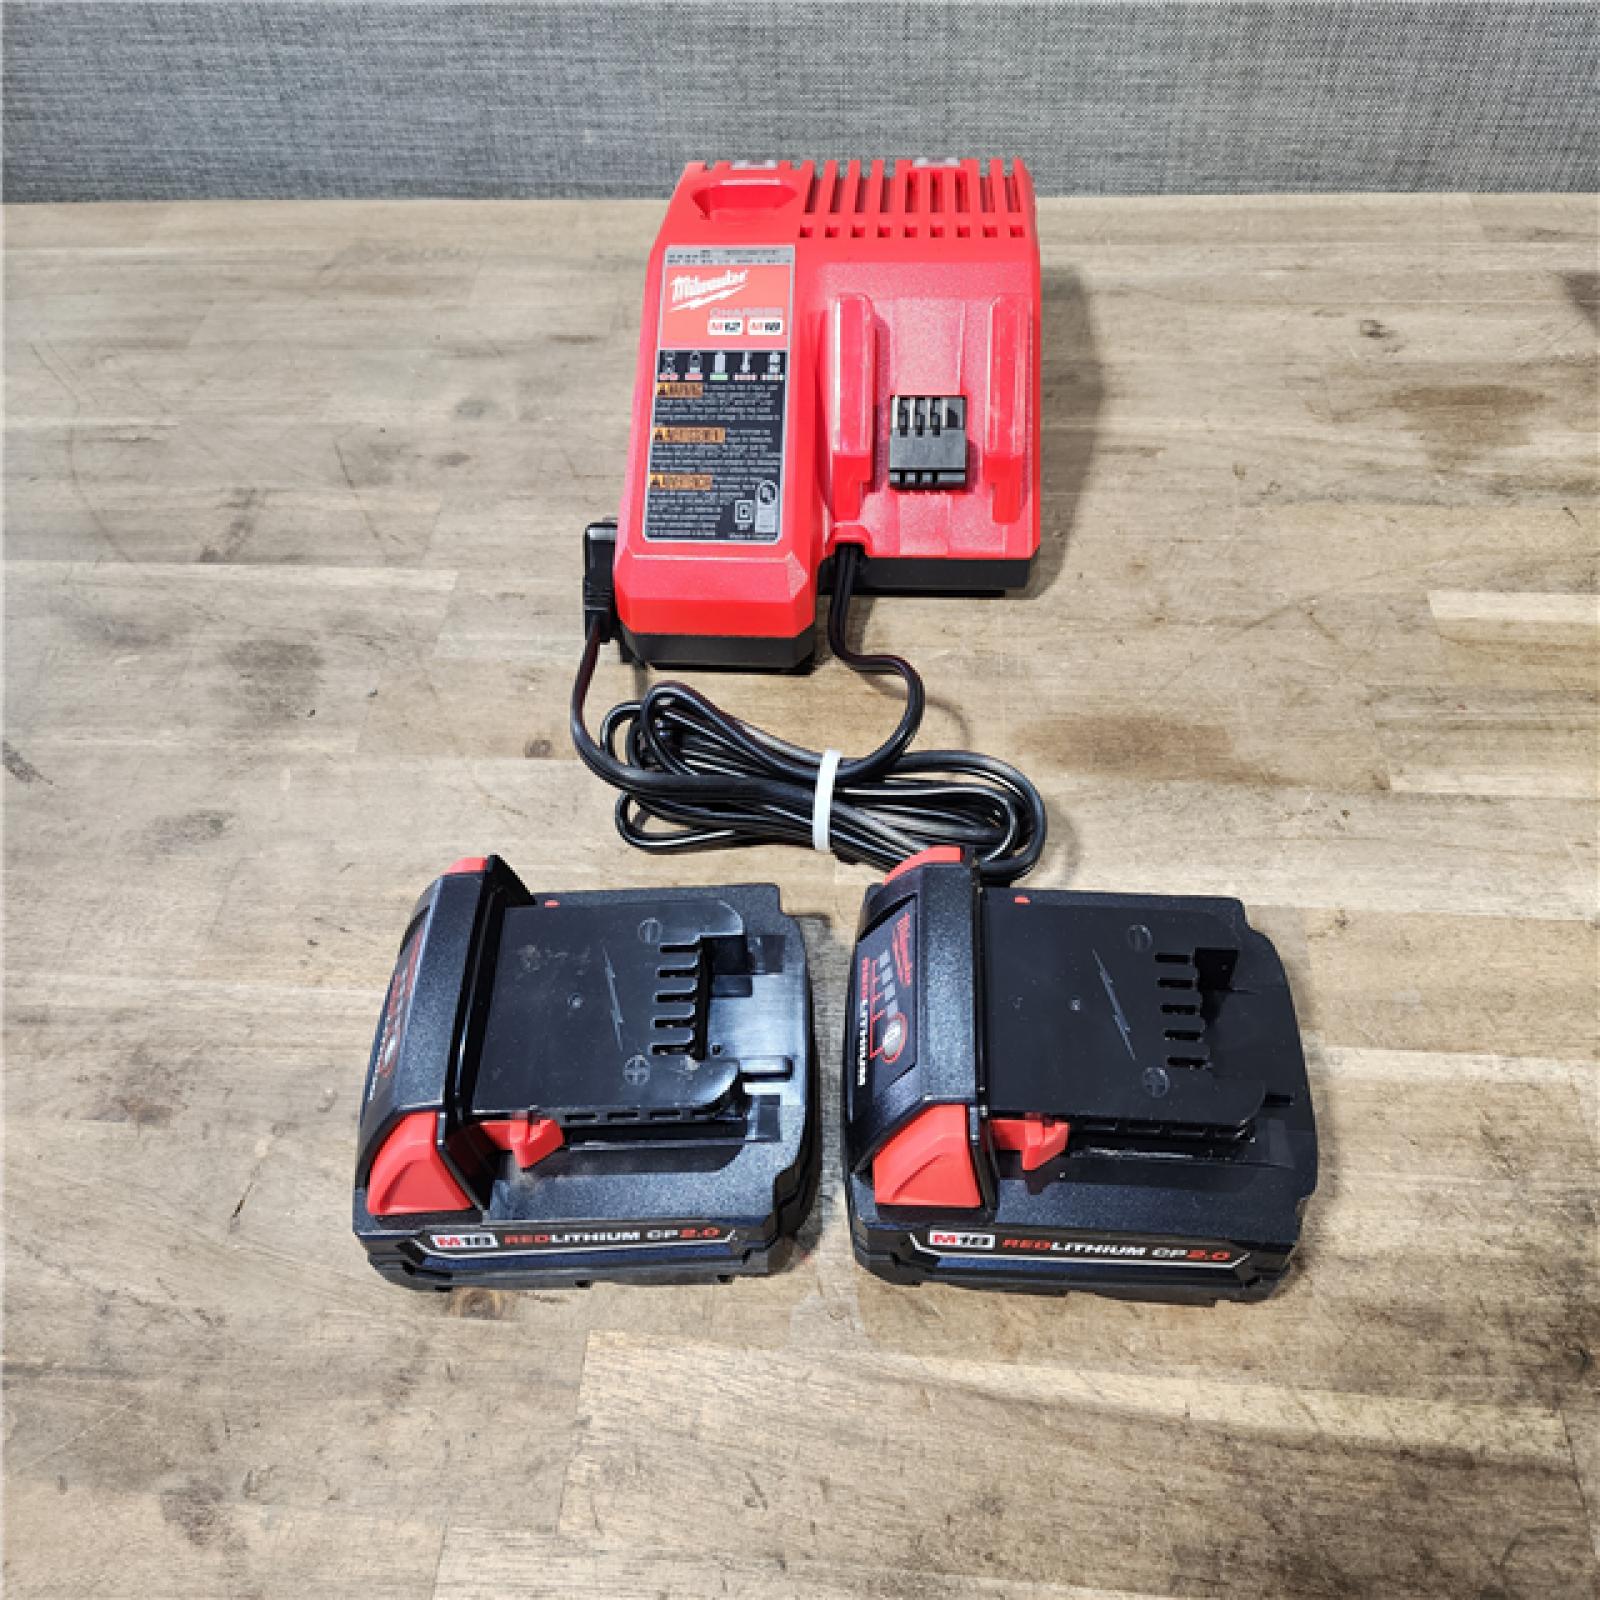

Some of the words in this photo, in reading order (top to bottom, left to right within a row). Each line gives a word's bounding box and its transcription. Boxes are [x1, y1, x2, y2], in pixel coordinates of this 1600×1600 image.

[436, 1235, 493, 1248] M18
[504, 1230, 640, 1245] REDLITHIUM
[933, 1233, 991, 1247] M18
[1002, 1238, 1146, 1256] REDLITHIUM
